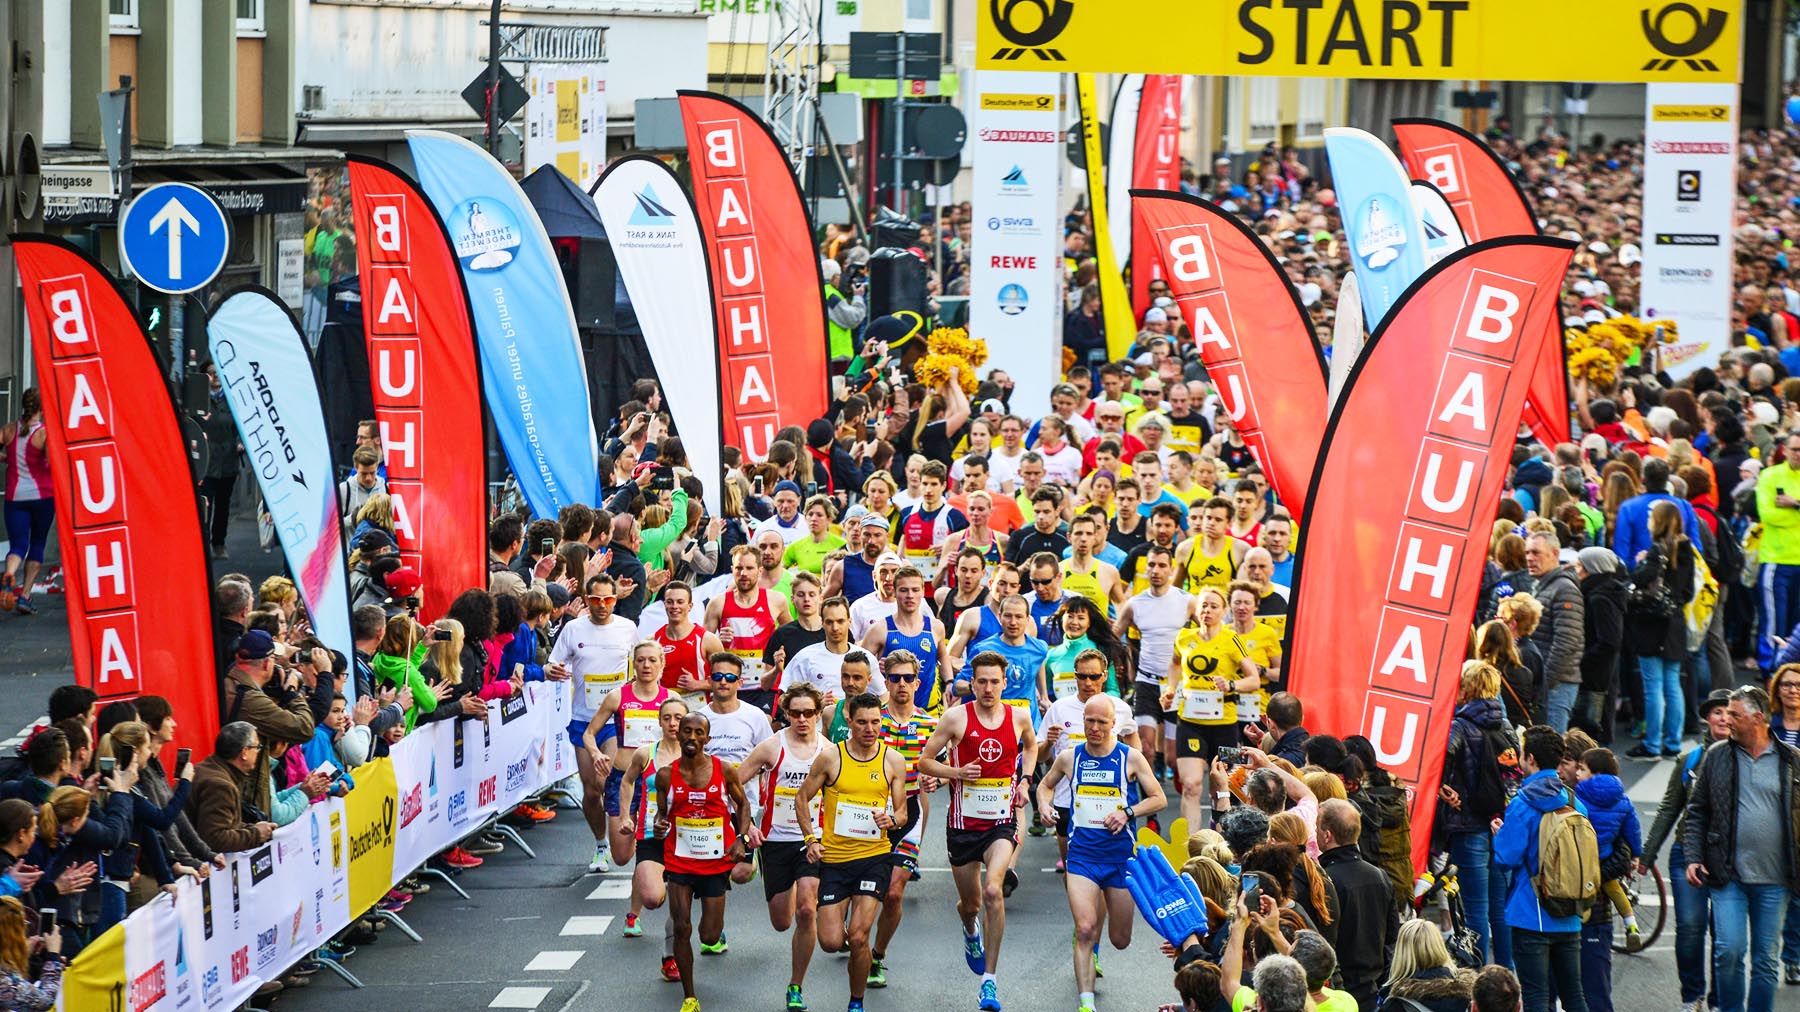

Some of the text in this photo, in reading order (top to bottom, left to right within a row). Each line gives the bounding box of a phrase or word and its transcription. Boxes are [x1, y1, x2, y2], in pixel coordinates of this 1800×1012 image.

[1238, 0, 1468, 67] START
[985, 99, 1034, 107] Deutsche Post
[991, 131, 1055, 142] BAUHAUS
[41, 174, 93, 189] heingasse
[991, 256, 1037, 269] REWE
[1369, 284, 1521, 766] BAUHAU
[507, 697, 525, 715] DIADORA
[478, 774, 497, 809] REWE
[853, 812, 869, 821] 1954
[350, 831, 372, 863] Deutsche
[371, 817, 383, 848] Post
[1164, 897, 1186, 911] SWB
[231, 944, 250, 987] REWE
